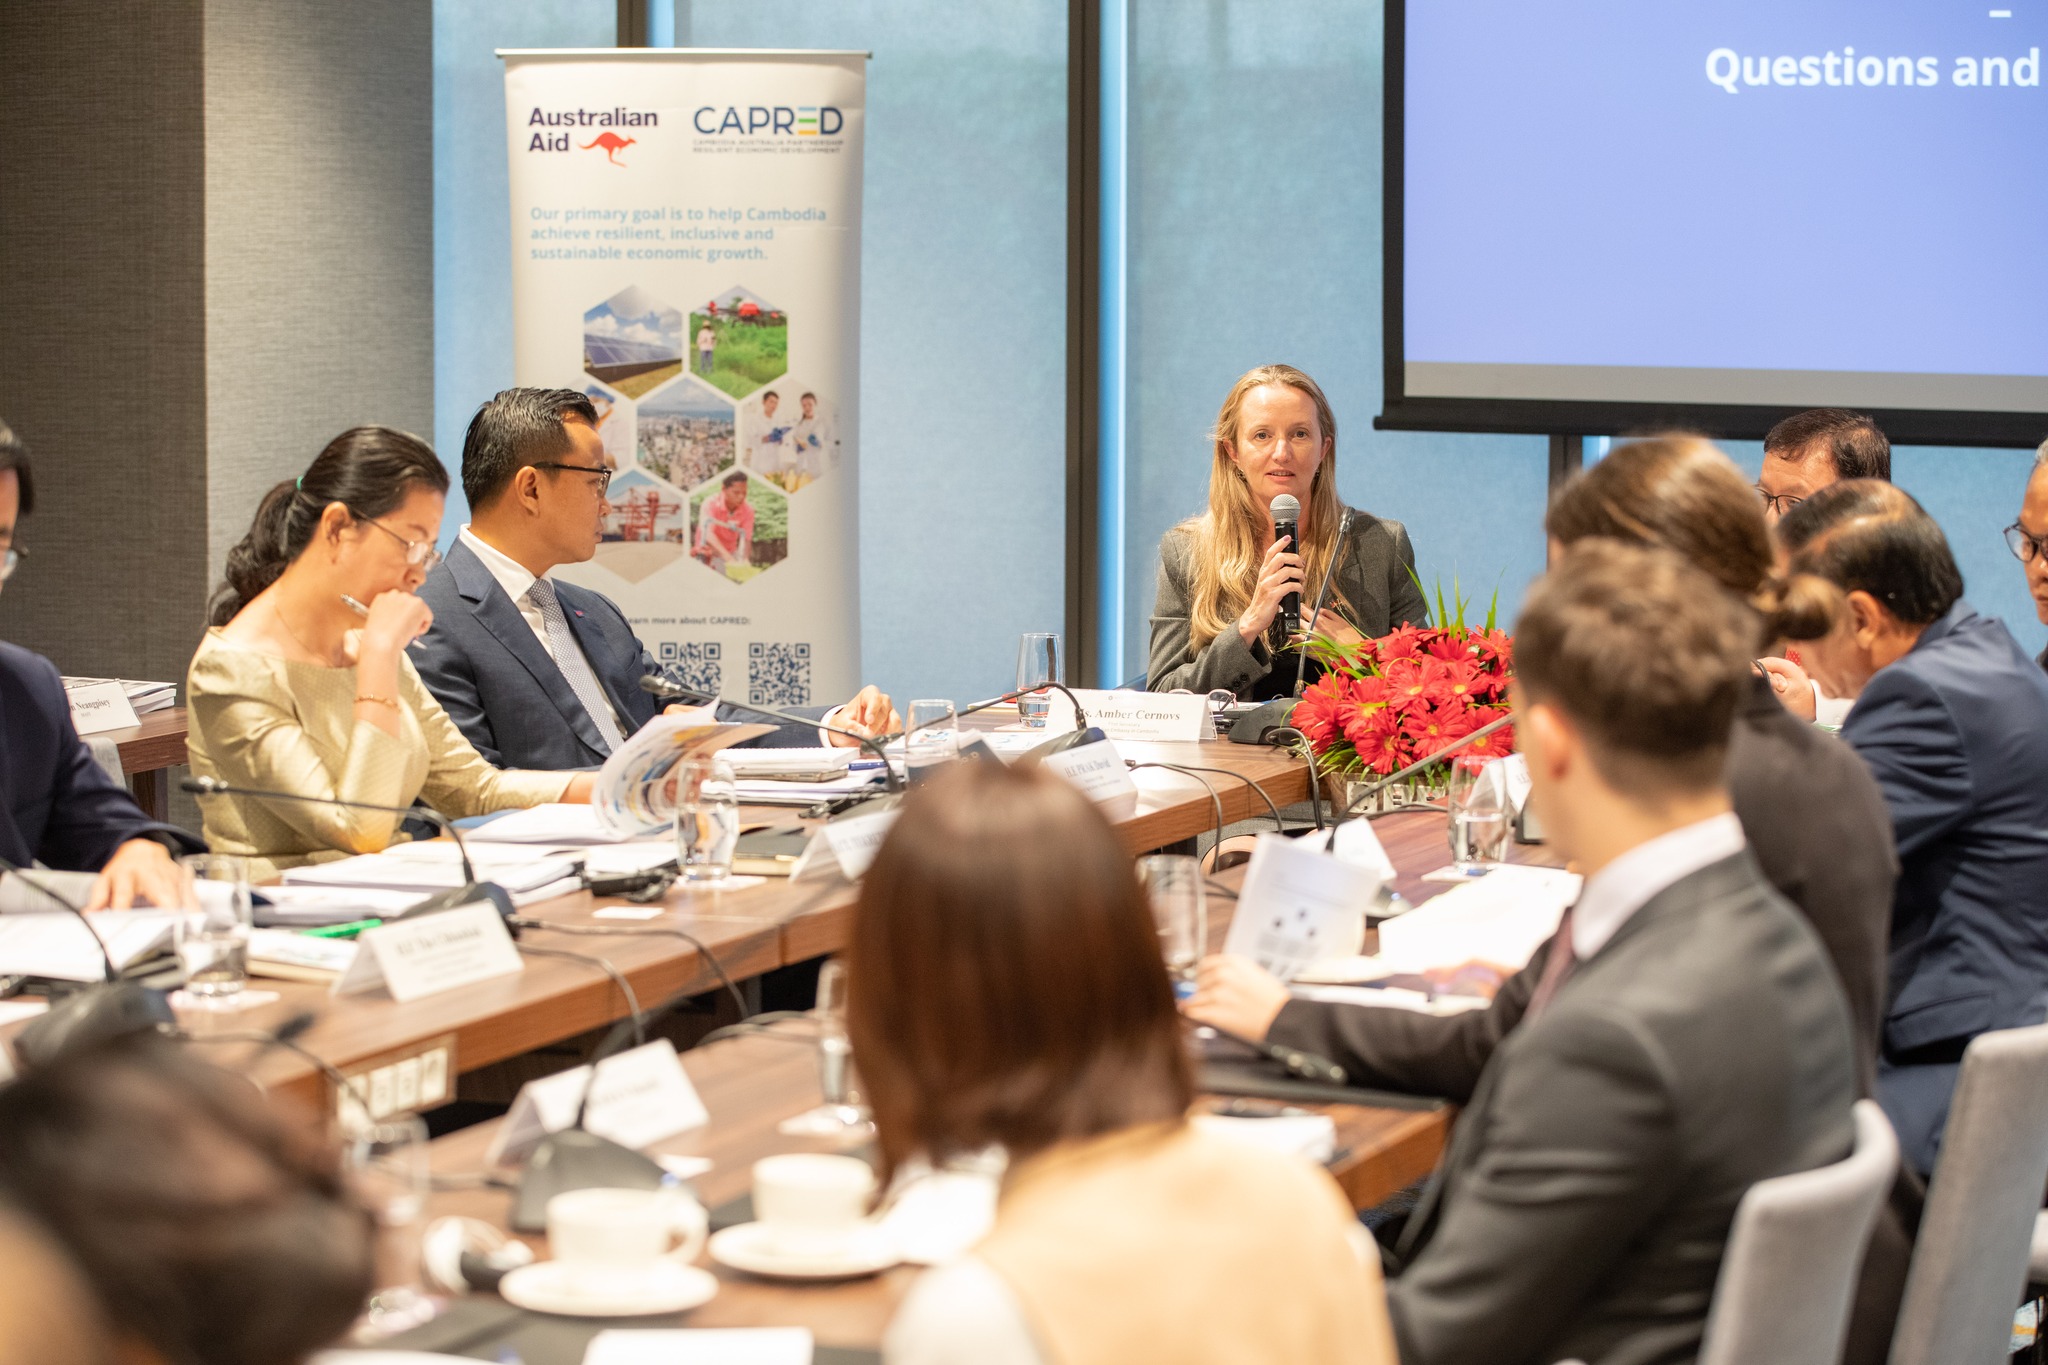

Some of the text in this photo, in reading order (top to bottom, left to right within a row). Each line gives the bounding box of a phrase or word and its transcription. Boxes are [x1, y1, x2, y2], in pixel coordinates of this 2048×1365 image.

[1705, 46, 2040, 94] Questions and
[529, 107, 658, 126] Australian
[693, 106, 843, 135] CAPRED
[529, 132, 569, 151] Aid
[530, 207, 827, 224] Our primary goal is to help Cambodia
[531, 227, 774, 241] achieve resilient, inclusive and
[531, 247, 769, 263] sustainable economic growth.
[679, 615, 707, 624] about
[709, 616, 751, 625] CAPRED:
[1095, 709, 1133, 719] Amber
[1136, 710, 1180, 720] Cernovs
